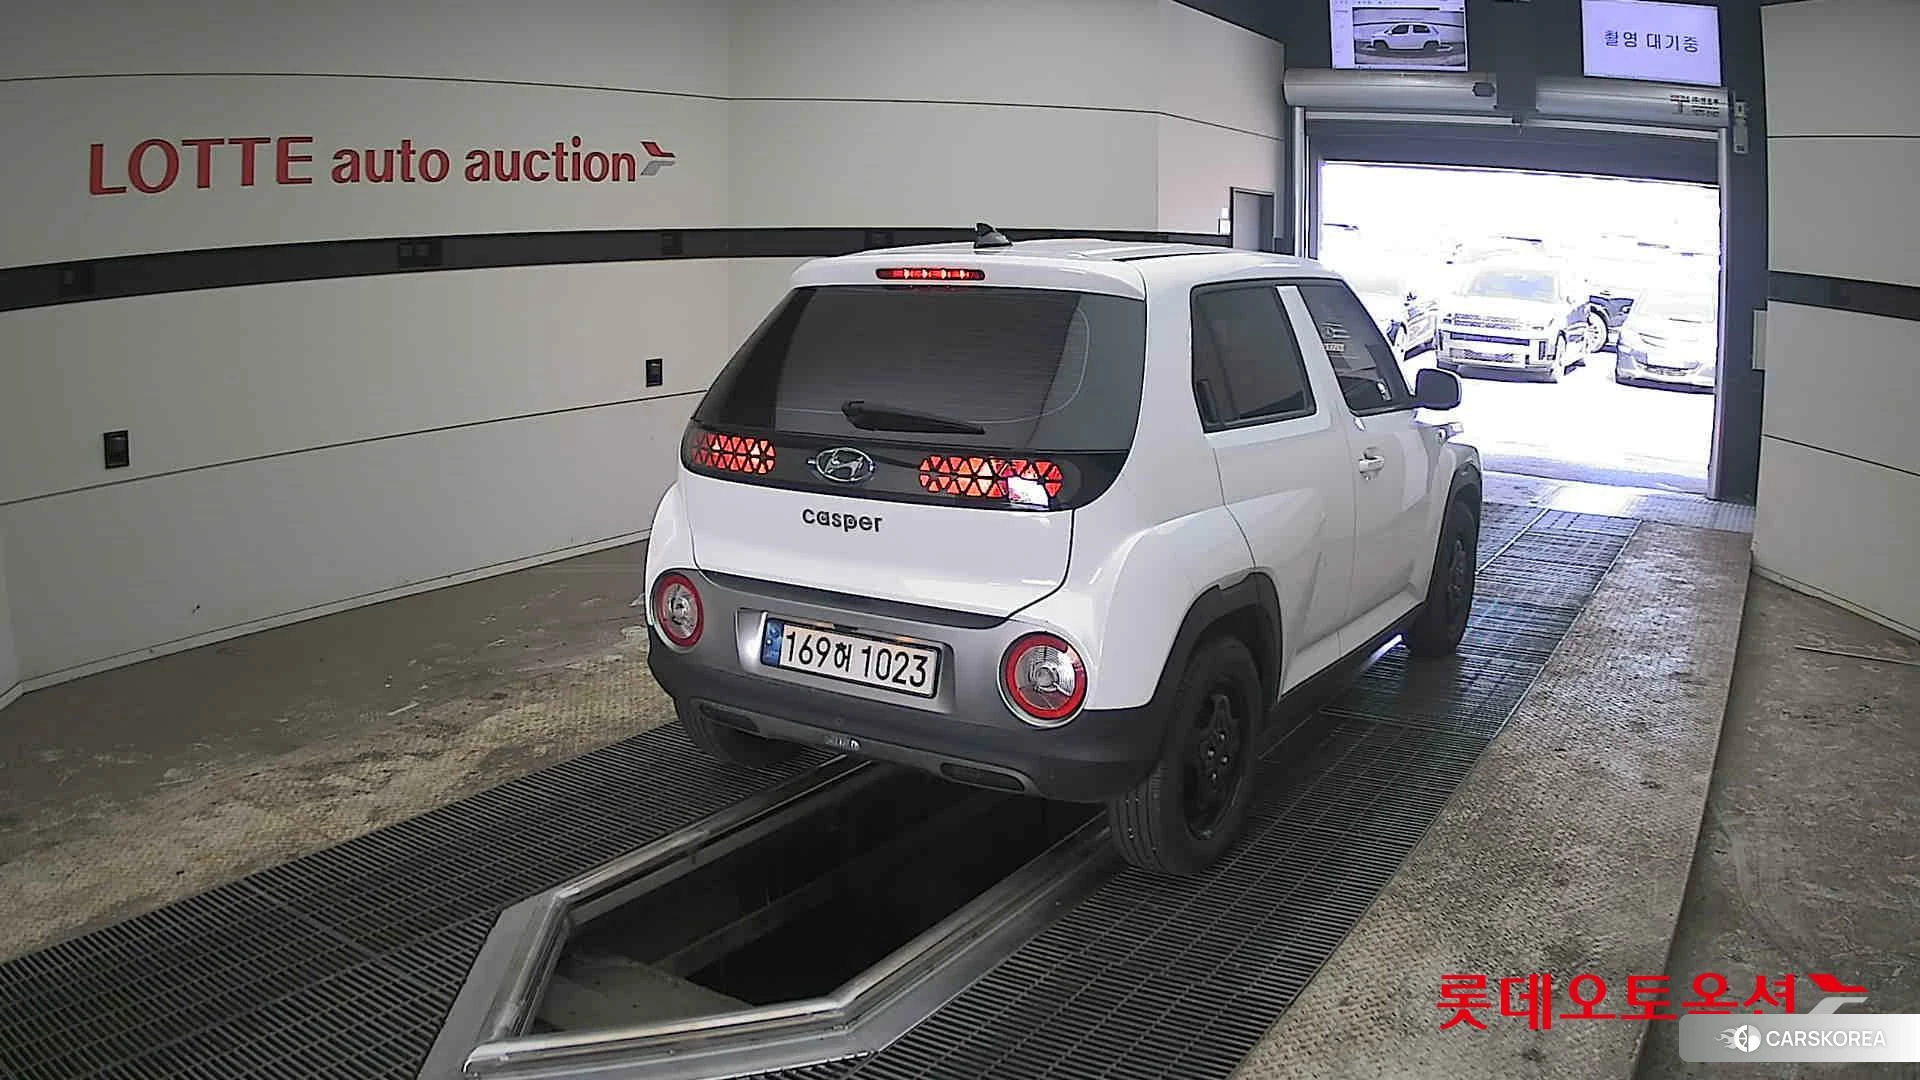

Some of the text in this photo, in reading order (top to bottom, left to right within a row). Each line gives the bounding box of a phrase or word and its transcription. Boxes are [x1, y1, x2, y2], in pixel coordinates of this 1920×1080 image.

[1646, 33, 1699, 53] 대기중
[89, 136, 636, 195] LOTTE auto auction
[802, 508, 883, 532] casper
[786, 631, 928, 687] 169허 1023
